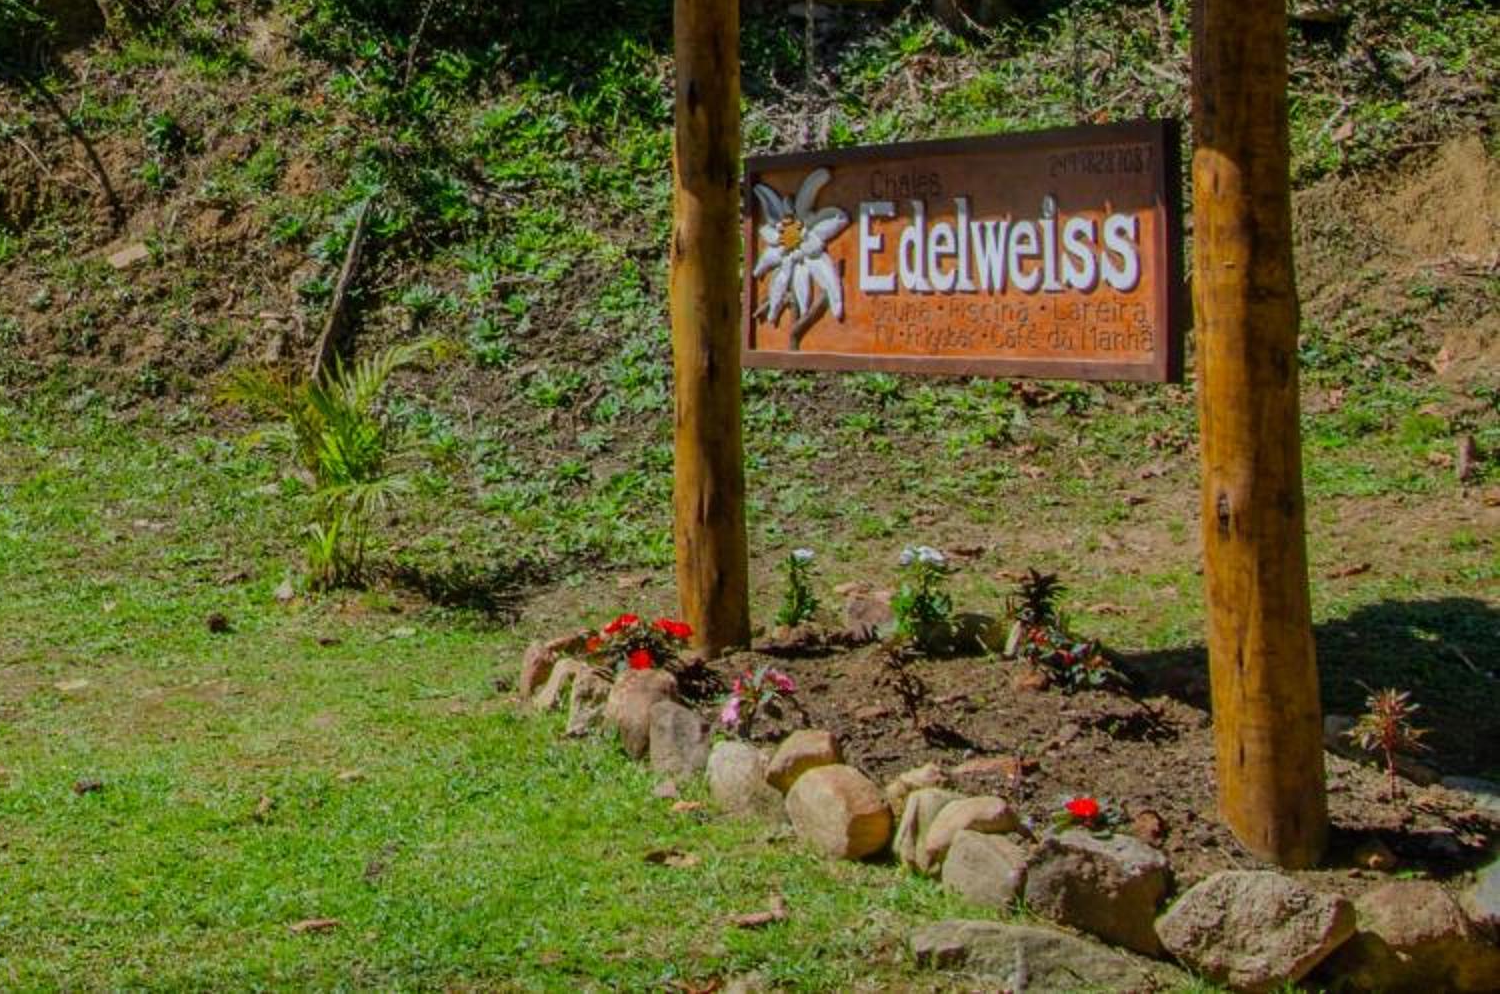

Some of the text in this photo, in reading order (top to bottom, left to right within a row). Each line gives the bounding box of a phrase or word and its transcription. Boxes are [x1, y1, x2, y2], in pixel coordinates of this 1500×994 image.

[859, 194, 1140, 294] Edelweiss
[948, 296, 1029, 321] Piscina
[1053, 296, 1147, 322] Lareira
